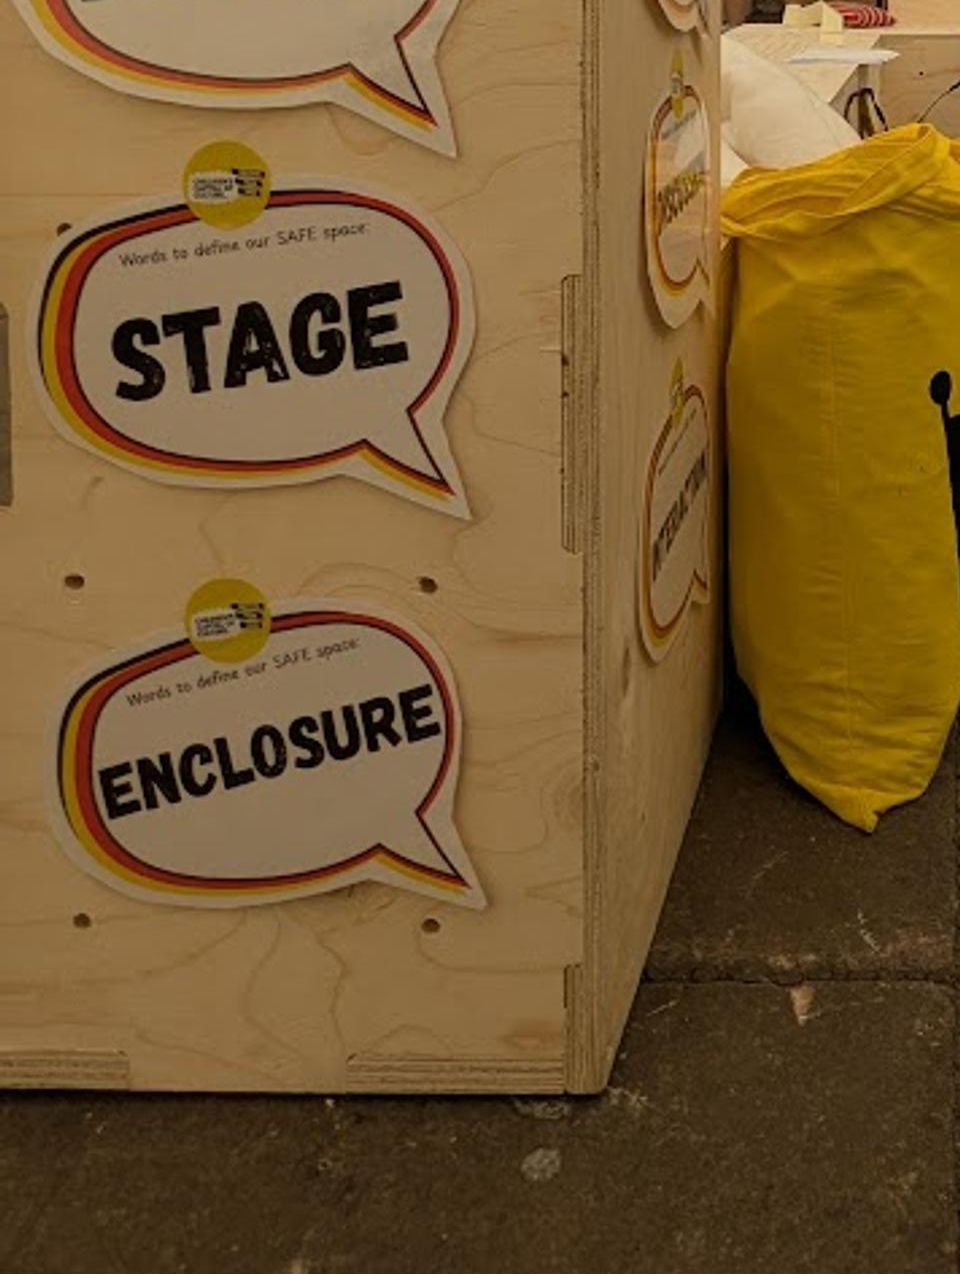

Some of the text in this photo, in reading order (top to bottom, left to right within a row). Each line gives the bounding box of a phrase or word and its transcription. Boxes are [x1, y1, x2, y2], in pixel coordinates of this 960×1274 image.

[118, 249, 168, 267] Words
[172, 245, 188, 259] to
[194, 237, 239, 257] define
[245, 234, 270, 249] our
[277, 226, 316, 246] SAFE
[111, 280, 409, 402] STAGE
[126, 683, 172, 707] Words
[177, 680, 191, 693] to
[196, 668, 239, 690] define
[245, 661, 267, 677] our
[273, 650, 311, 669] SAFE
[98, 683, 441, 821] ENCLOSURE
